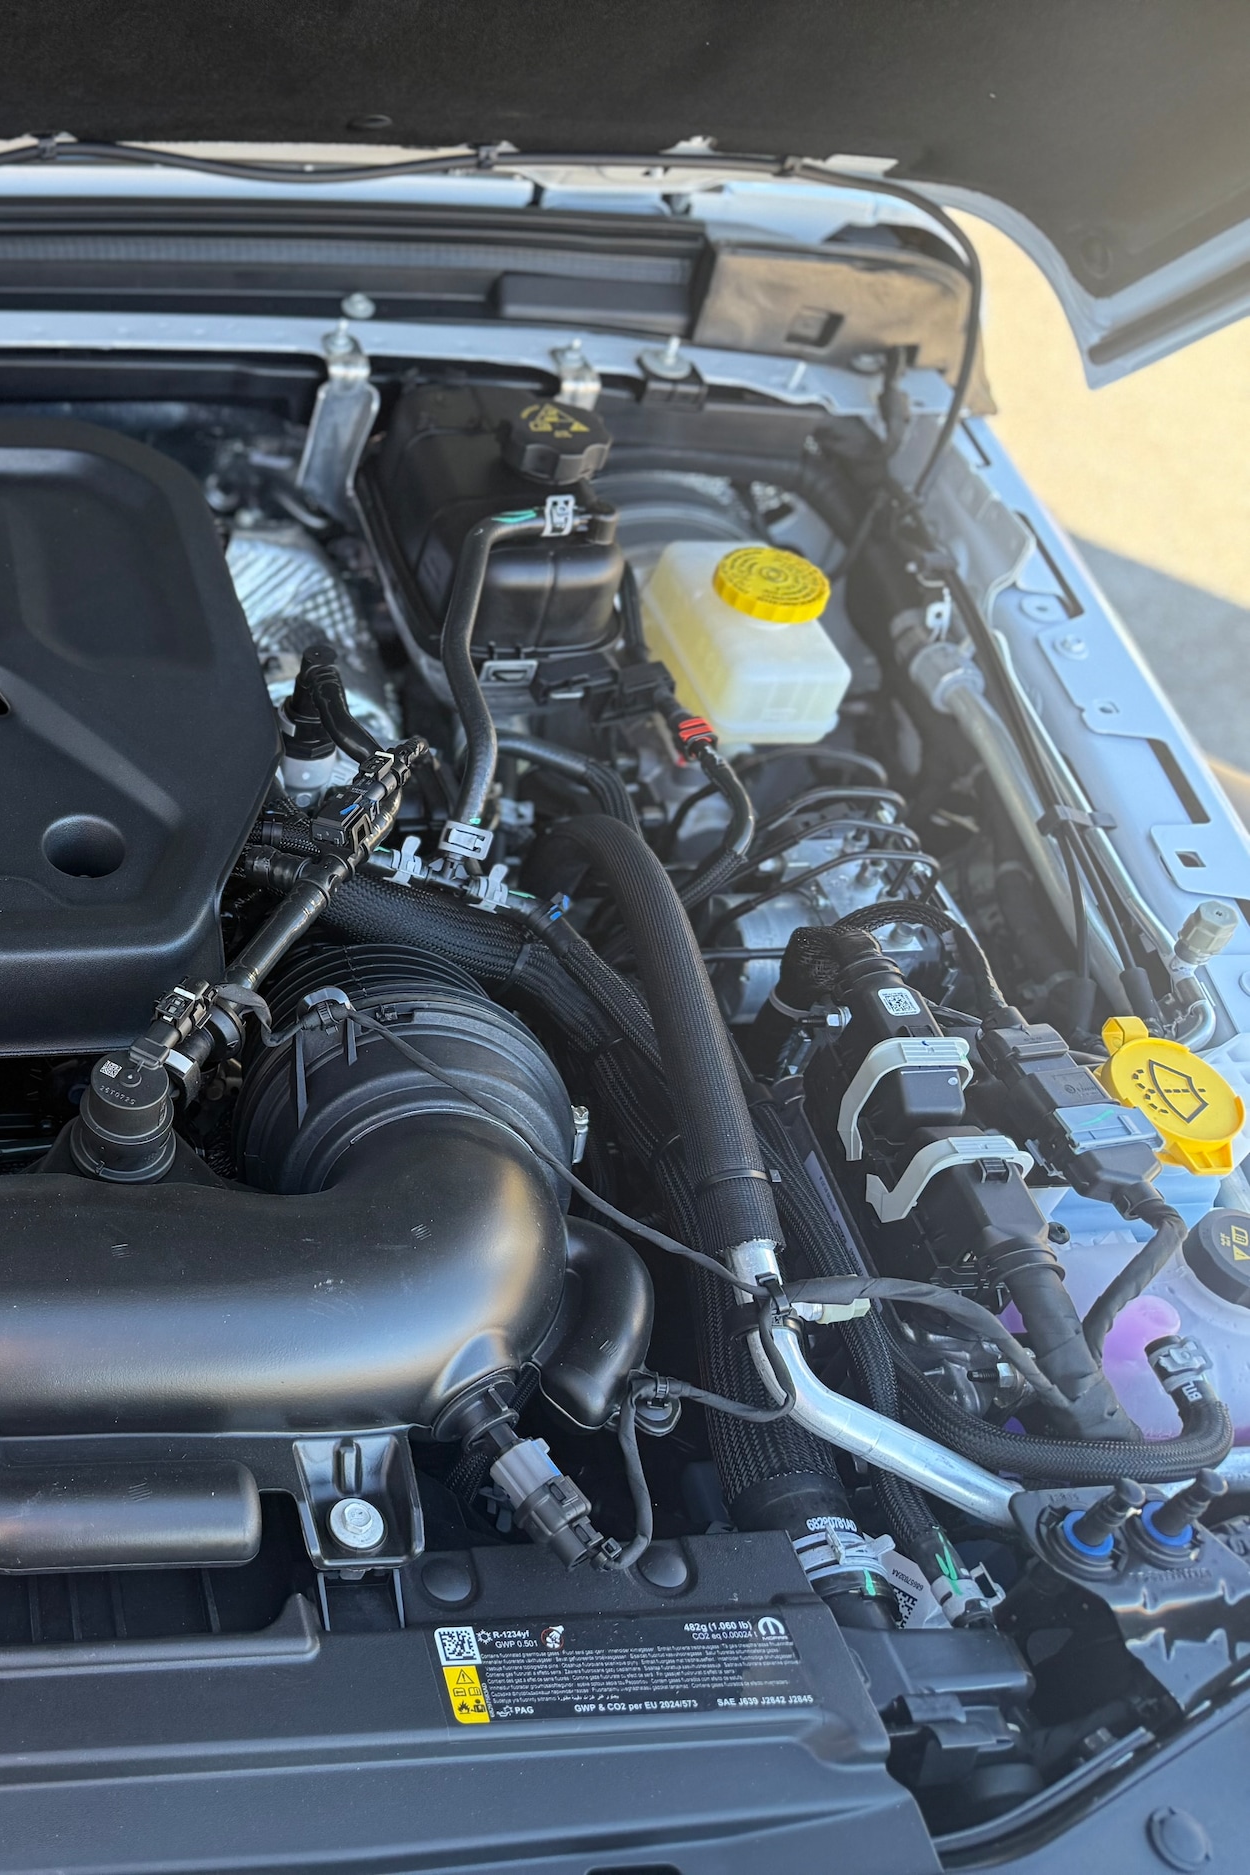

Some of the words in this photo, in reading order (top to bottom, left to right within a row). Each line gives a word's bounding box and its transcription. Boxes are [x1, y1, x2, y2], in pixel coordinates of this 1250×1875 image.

[683, 1622, 708, 1632] 482g
[708, 1621, 737, 1632] (1.060
[739, 1620, 753, 1631] lb)
[492, 1630, 530, 1639] R-1234yf
[692, 1632, 710, 1641] CO2
[711, 1633, 722, 1641] eq
[722, 1631, 753, 1639] 0.00024
[495, 1640, 515, 1649] GWP
[516, 1639, 538, 1648] 0.501
[716, 1697, 736, 1707] SAE
[738, 1696, 759, 1706] J639
[760, 1695, 786, 1706] J2842
[788, 1694, 814, 1704] J2845
[515, 1706, 534, 1715] PAG
[574, 1704, 596, 1713] GWP
[599, 1703, 606, 1712] &
[606, 1702, 627, 1712] CO2
[628, 1703, 643, 1713] per
[645, 1701, 658, 1711] EU
[659, 1699, 699, 1709] 2024/573
